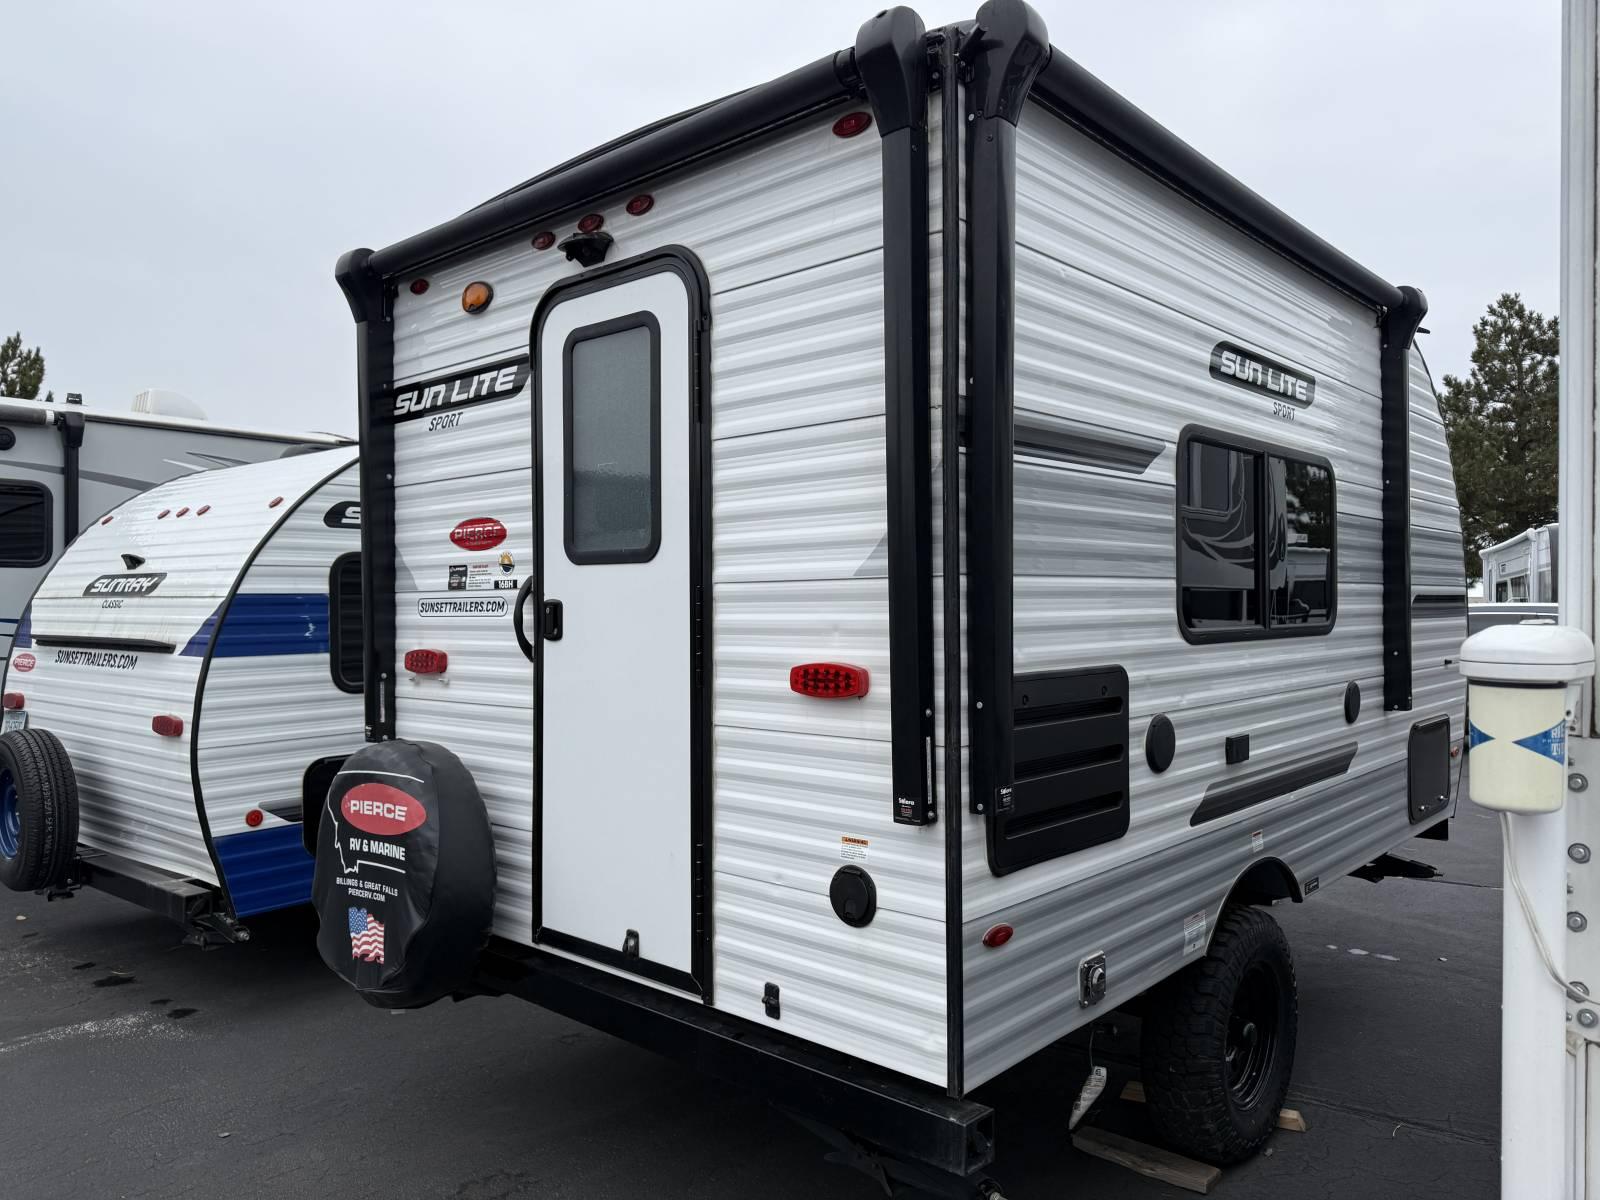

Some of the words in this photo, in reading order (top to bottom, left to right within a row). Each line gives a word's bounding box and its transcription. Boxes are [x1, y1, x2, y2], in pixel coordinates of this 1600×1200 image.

[1220, 350, 1262, 386] SUN
[1267, 367, 1308, 401] LITE
[393, 383, 446, 416] SUN
[451, 365, 518, 403] LITE
[428, 411, 464, 432] SPORT
[1273, 401, 1295, 421] SPORT
[454, 526, 501, 540] PIERCE
[89, 577, 159, 593] SUNRAY
[101, 599, 124, 609] CLASSIC
[420, 601, 505, 613] SUNSETTRAILERS.COM
[55, 649, 138, 670] SUNSETTRAILERS.COM
[350, 799, 408, 822] PIERCE
[349, 838, 362, 851] RV
[362, 839, 369, 852] &
[370, 840, 406, 861] MARINE
[336, 876, 359, 888] BILLINGS
[359, 880, 364, 888] &
[364, 881, 382, 892] GREAT
[382, 885, 398, 897] FALLS
[348, 887, 386, 902] PIERCERV.COM
